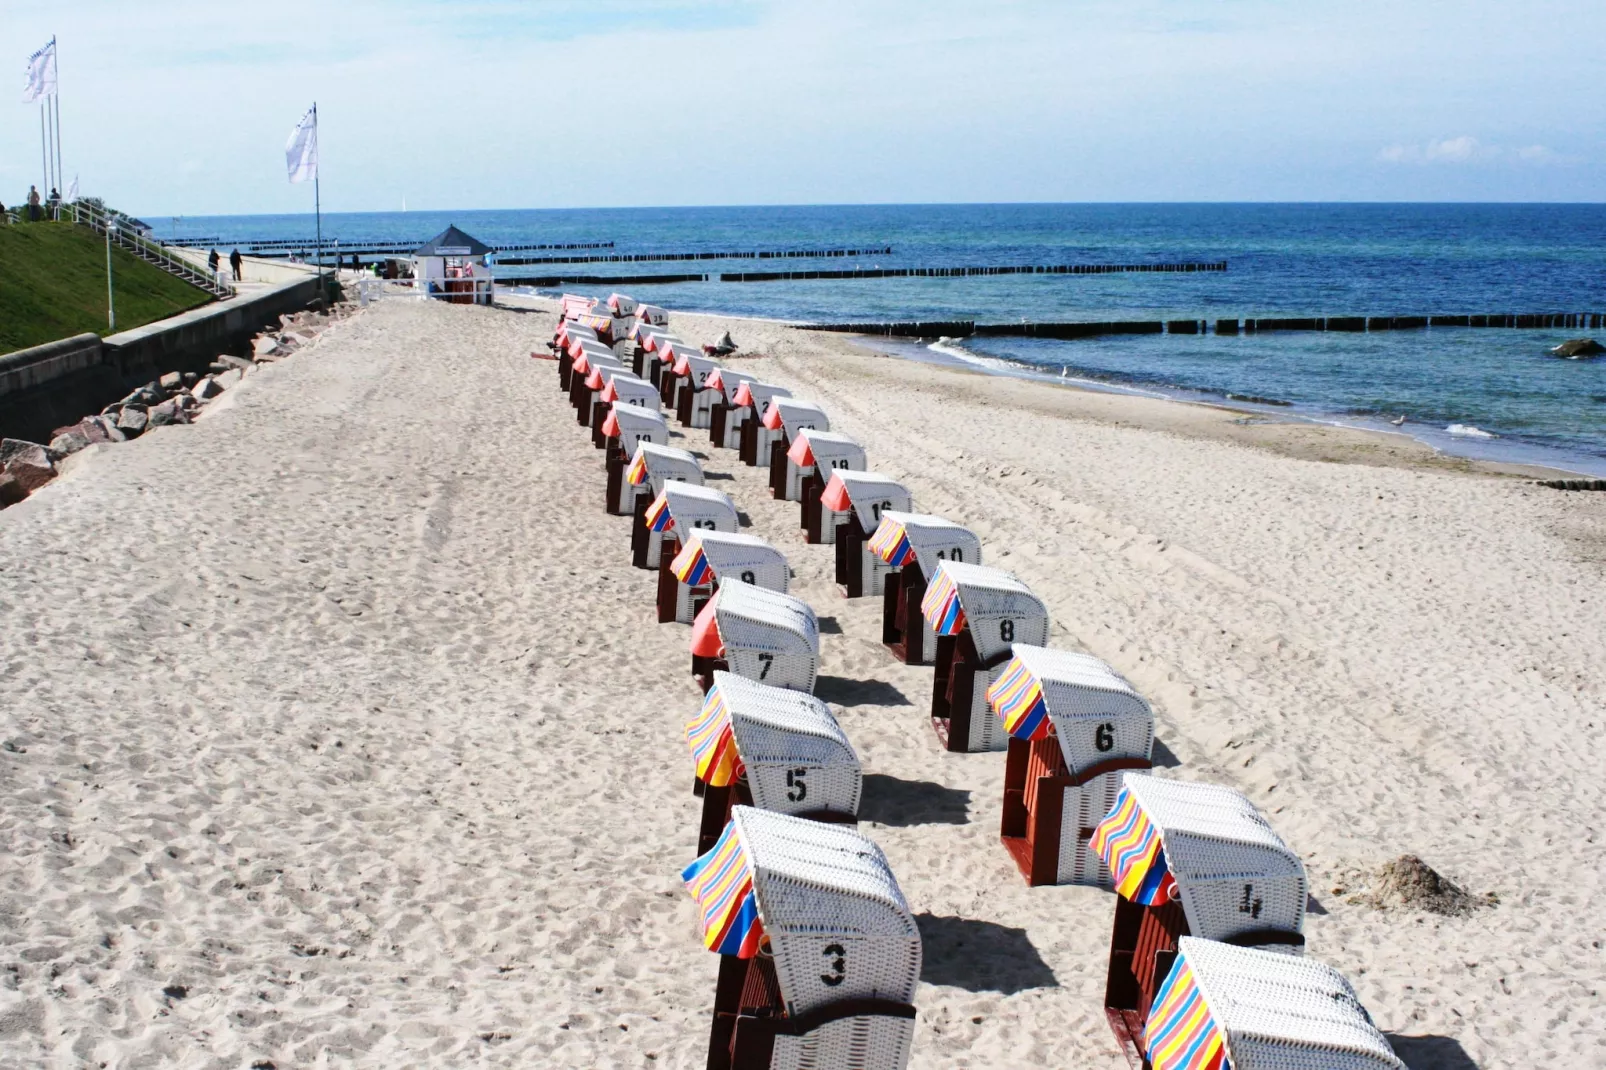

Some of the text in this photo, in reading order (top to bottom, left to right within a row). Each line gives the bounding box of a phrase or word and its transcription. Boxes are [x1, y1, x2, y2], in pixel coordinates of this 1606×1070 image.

[700, 372, 711, 383] 2
[1000, 619, 1014, 642] 8
[758, 653, 773, 680] 7
[1095, 722, 1115, 752] 6
[786, 769, 806, 802] 5
[1238, 884, 1263, 919] 4
[820, 943, 846, 987] 3
